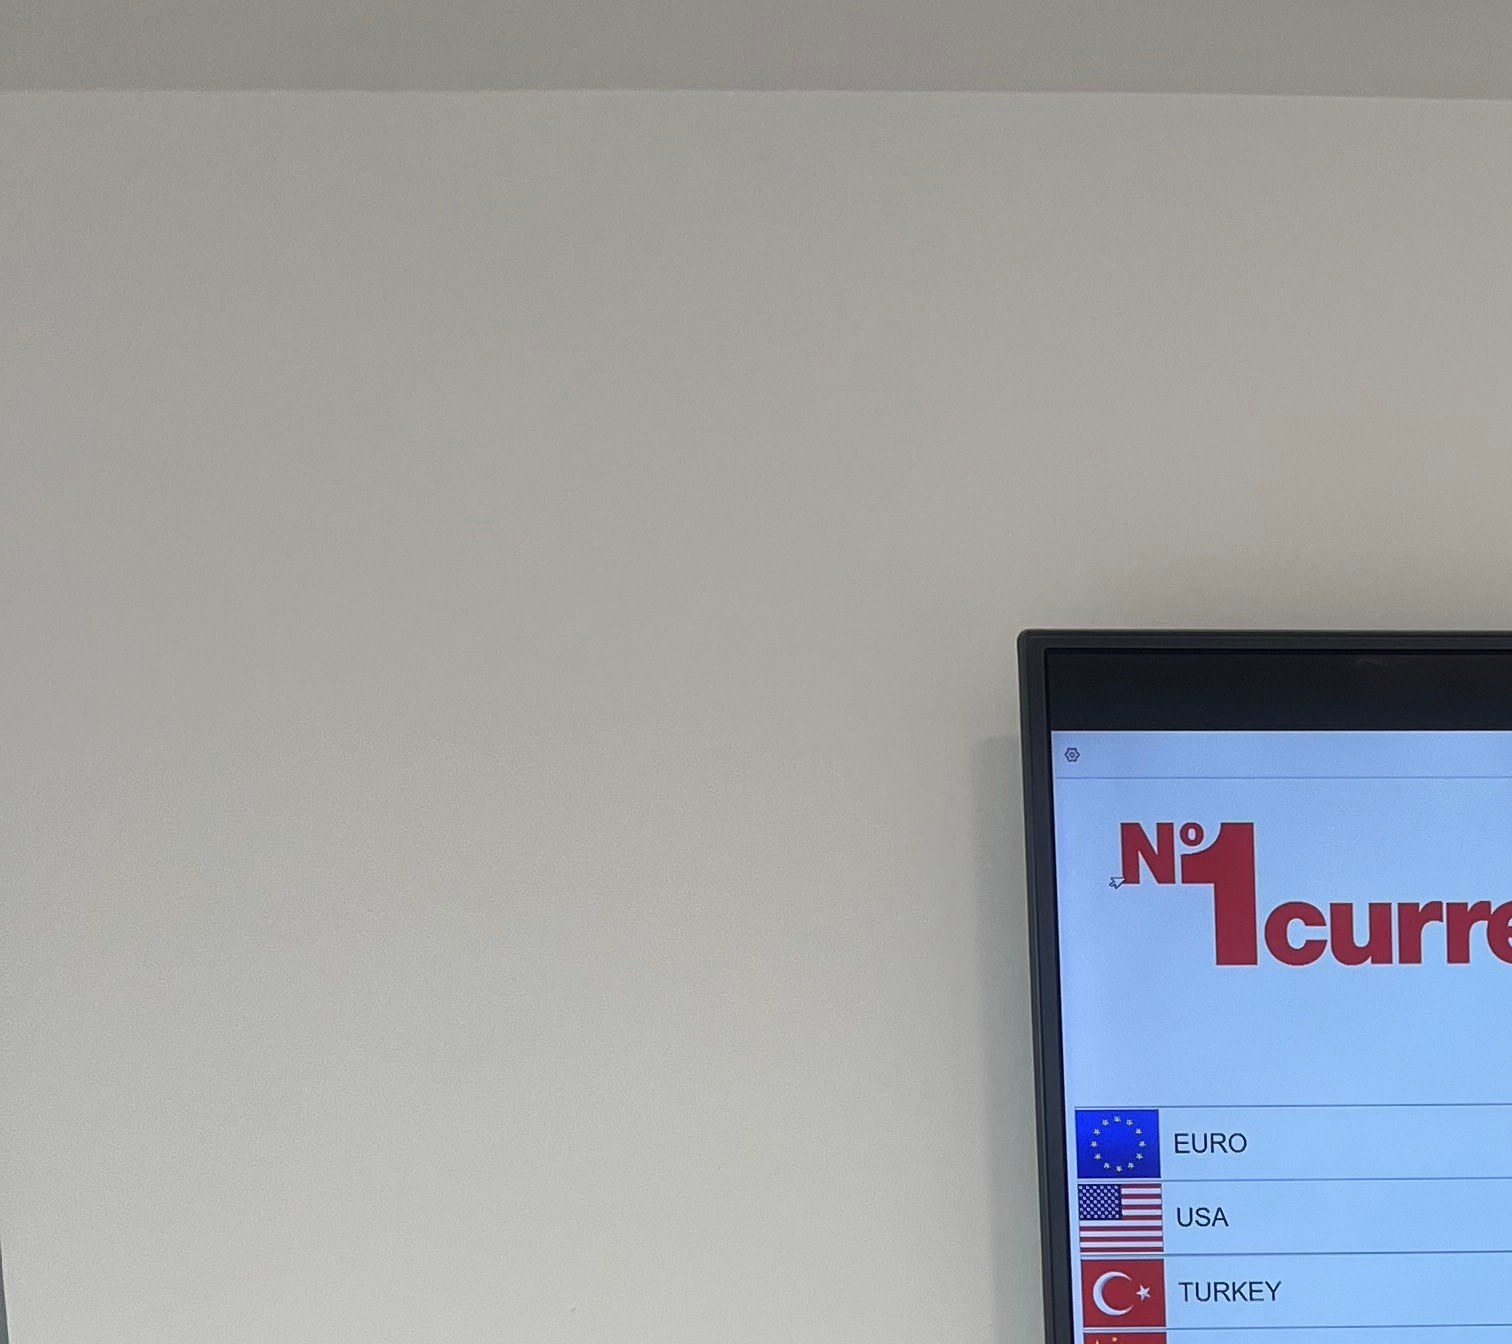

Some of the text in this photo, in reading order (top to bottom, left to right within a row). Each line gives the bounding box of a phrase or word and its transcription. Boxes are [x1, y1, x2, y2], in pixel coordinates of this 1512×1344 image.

[1175, 1133, 1247, 1153] EURO
[1177, 1207, 1229, 1227] USA
[1179, 1281, 1281, 1302] TURKEY
